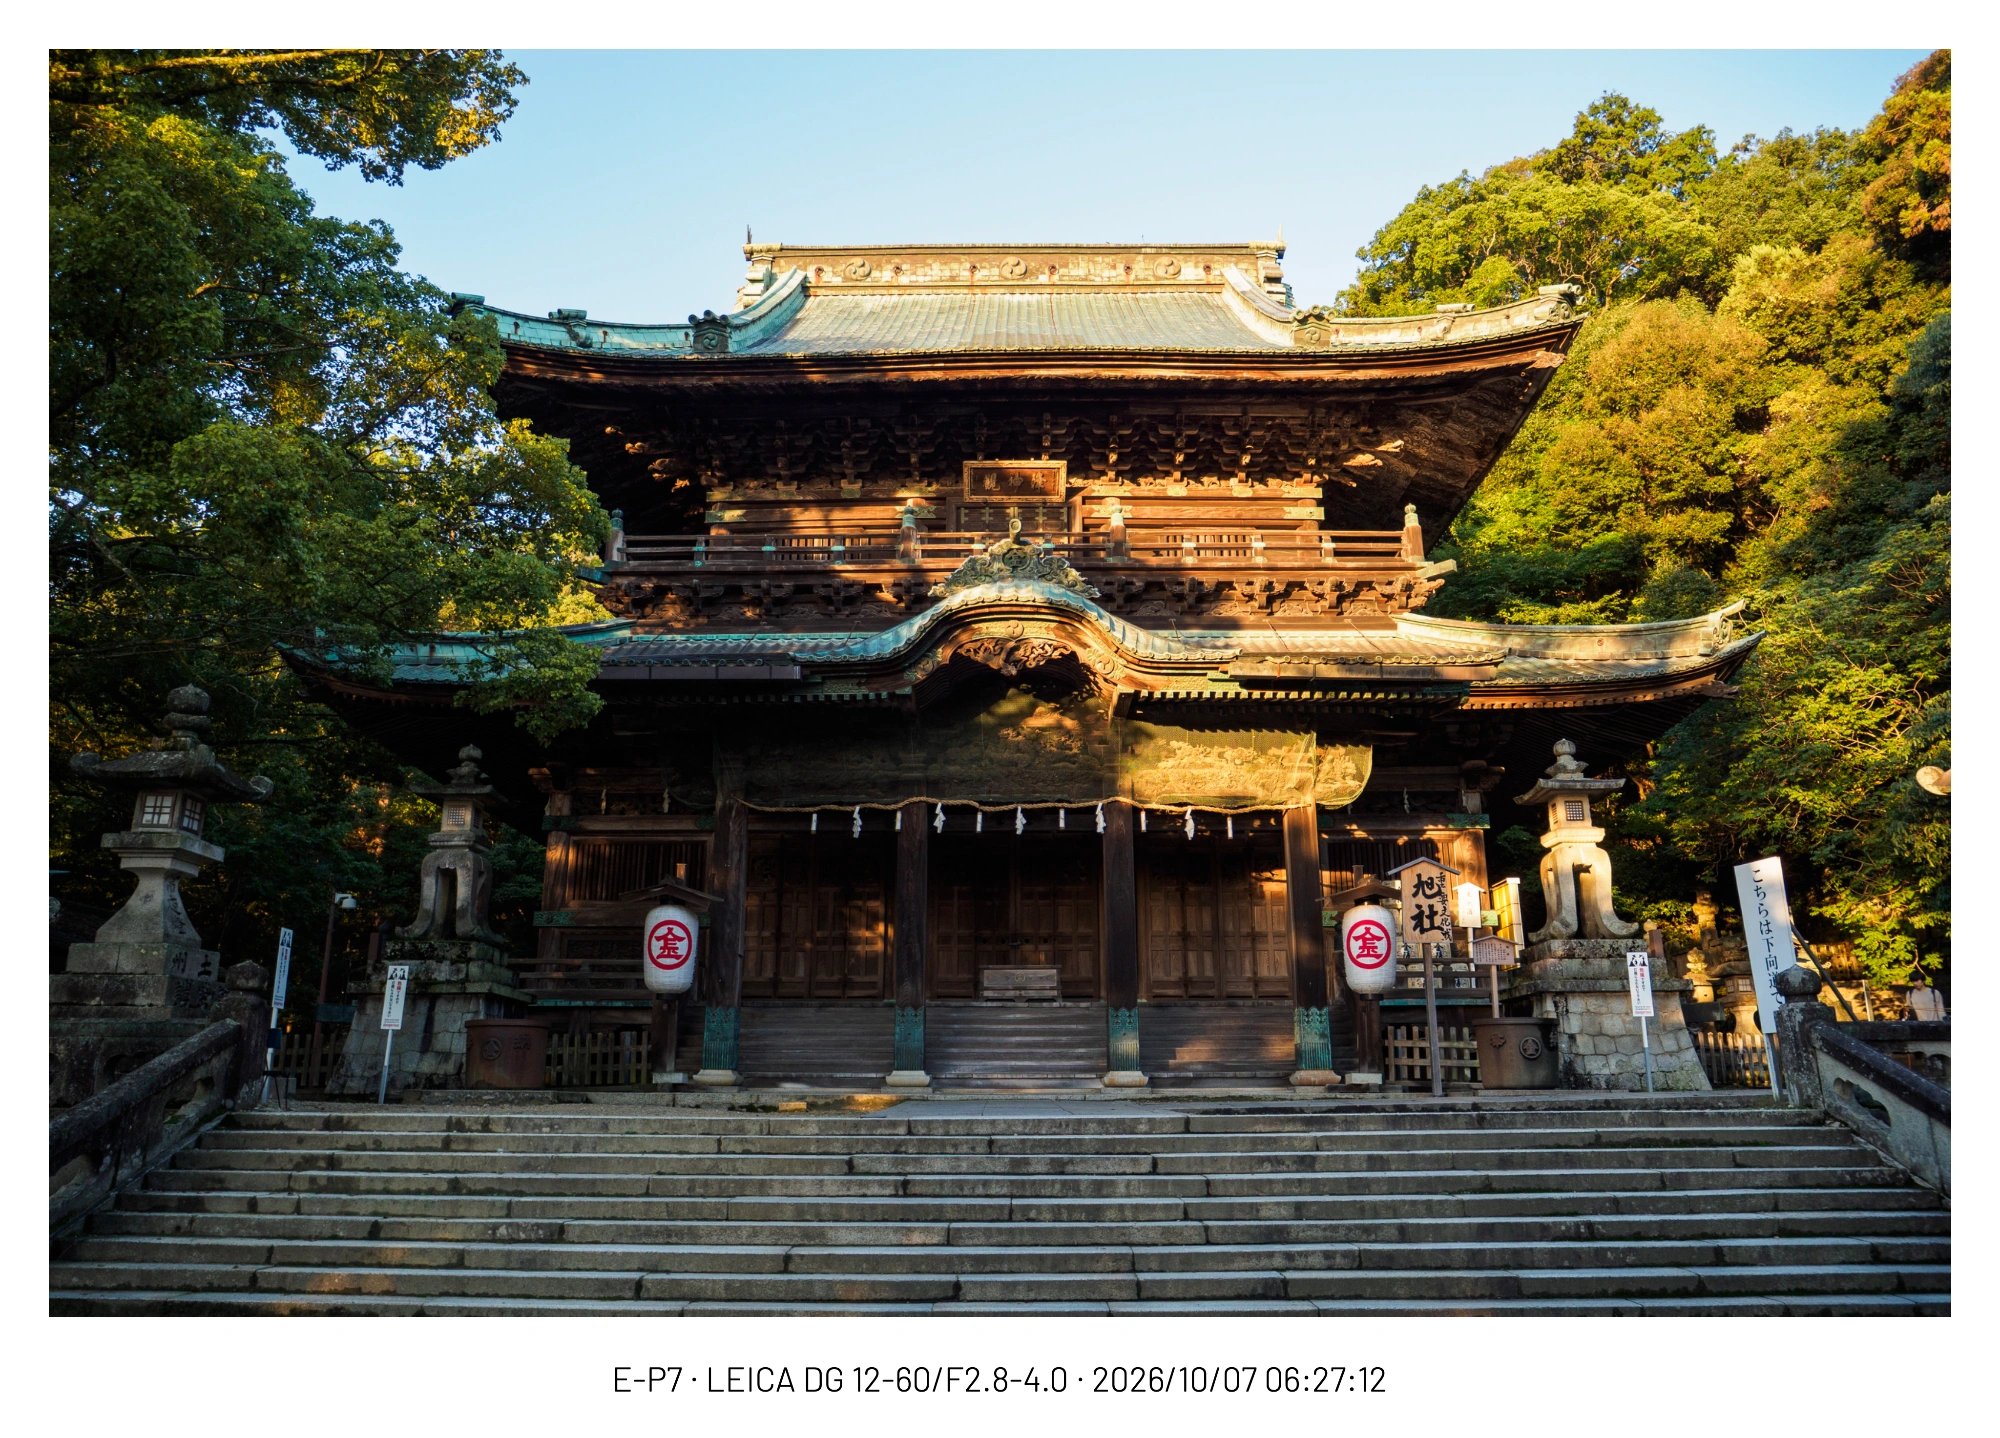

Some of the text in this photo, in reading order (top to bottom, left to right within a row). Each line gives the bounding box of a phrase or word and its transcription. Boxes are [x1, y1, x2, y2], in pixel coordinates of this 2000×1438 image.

[1409, 872, 1444, 935] 旭社
[653, 926, 687, 961] 金
[1351, 926, 1385, 960] 金
[1752, 868, 1784, 1010] こちらは下向道で
